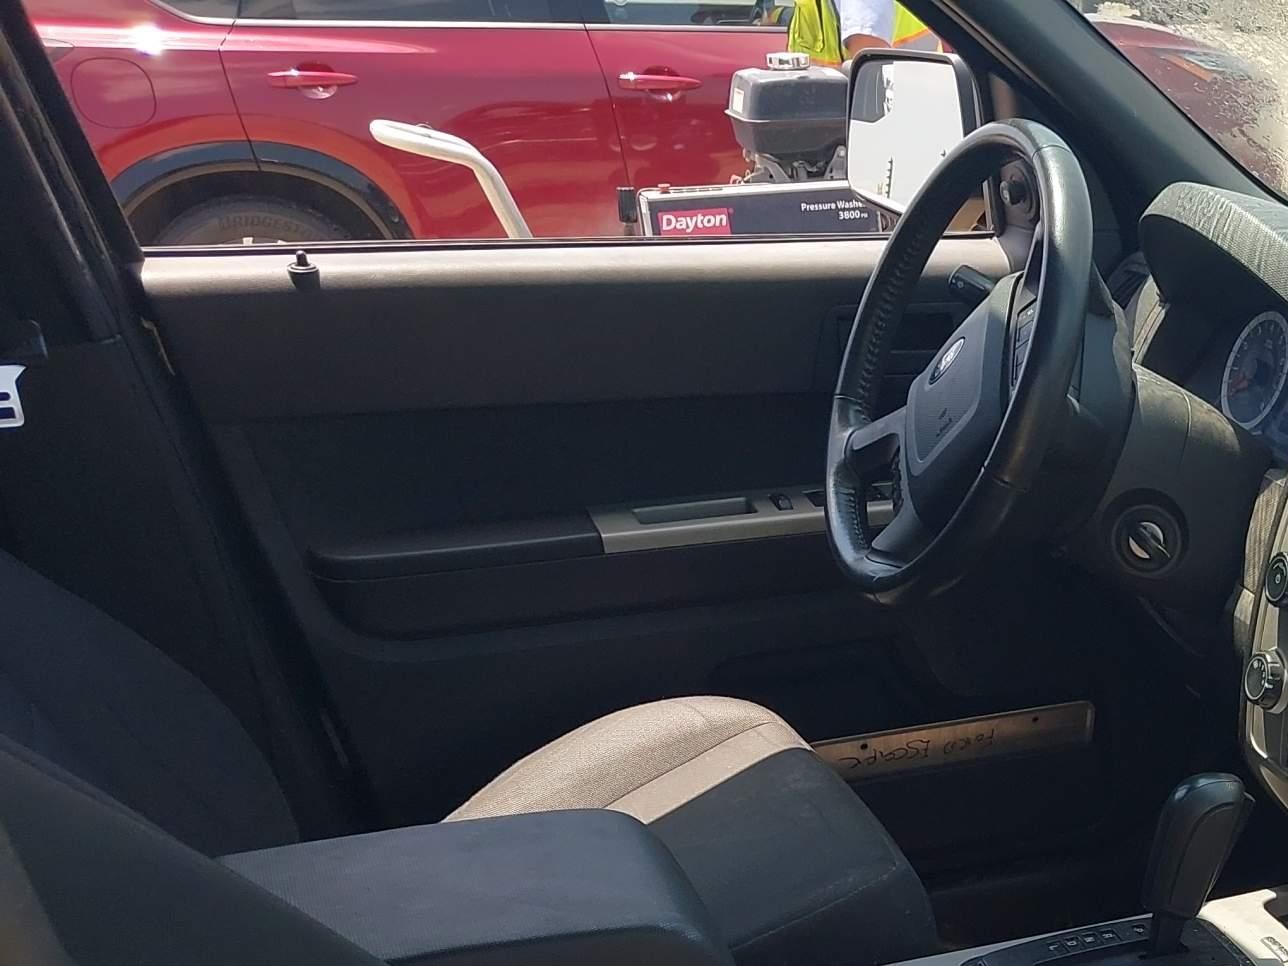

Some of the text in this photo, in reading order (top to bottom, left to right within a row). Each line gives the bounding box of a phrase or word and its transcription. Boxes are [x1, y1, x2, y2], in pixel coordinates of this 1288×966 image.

[801, 199, 866, 212] Pressure Washe
[838, 210, 860, 220] 3800
[661, 213, 727, 233] Dayton
